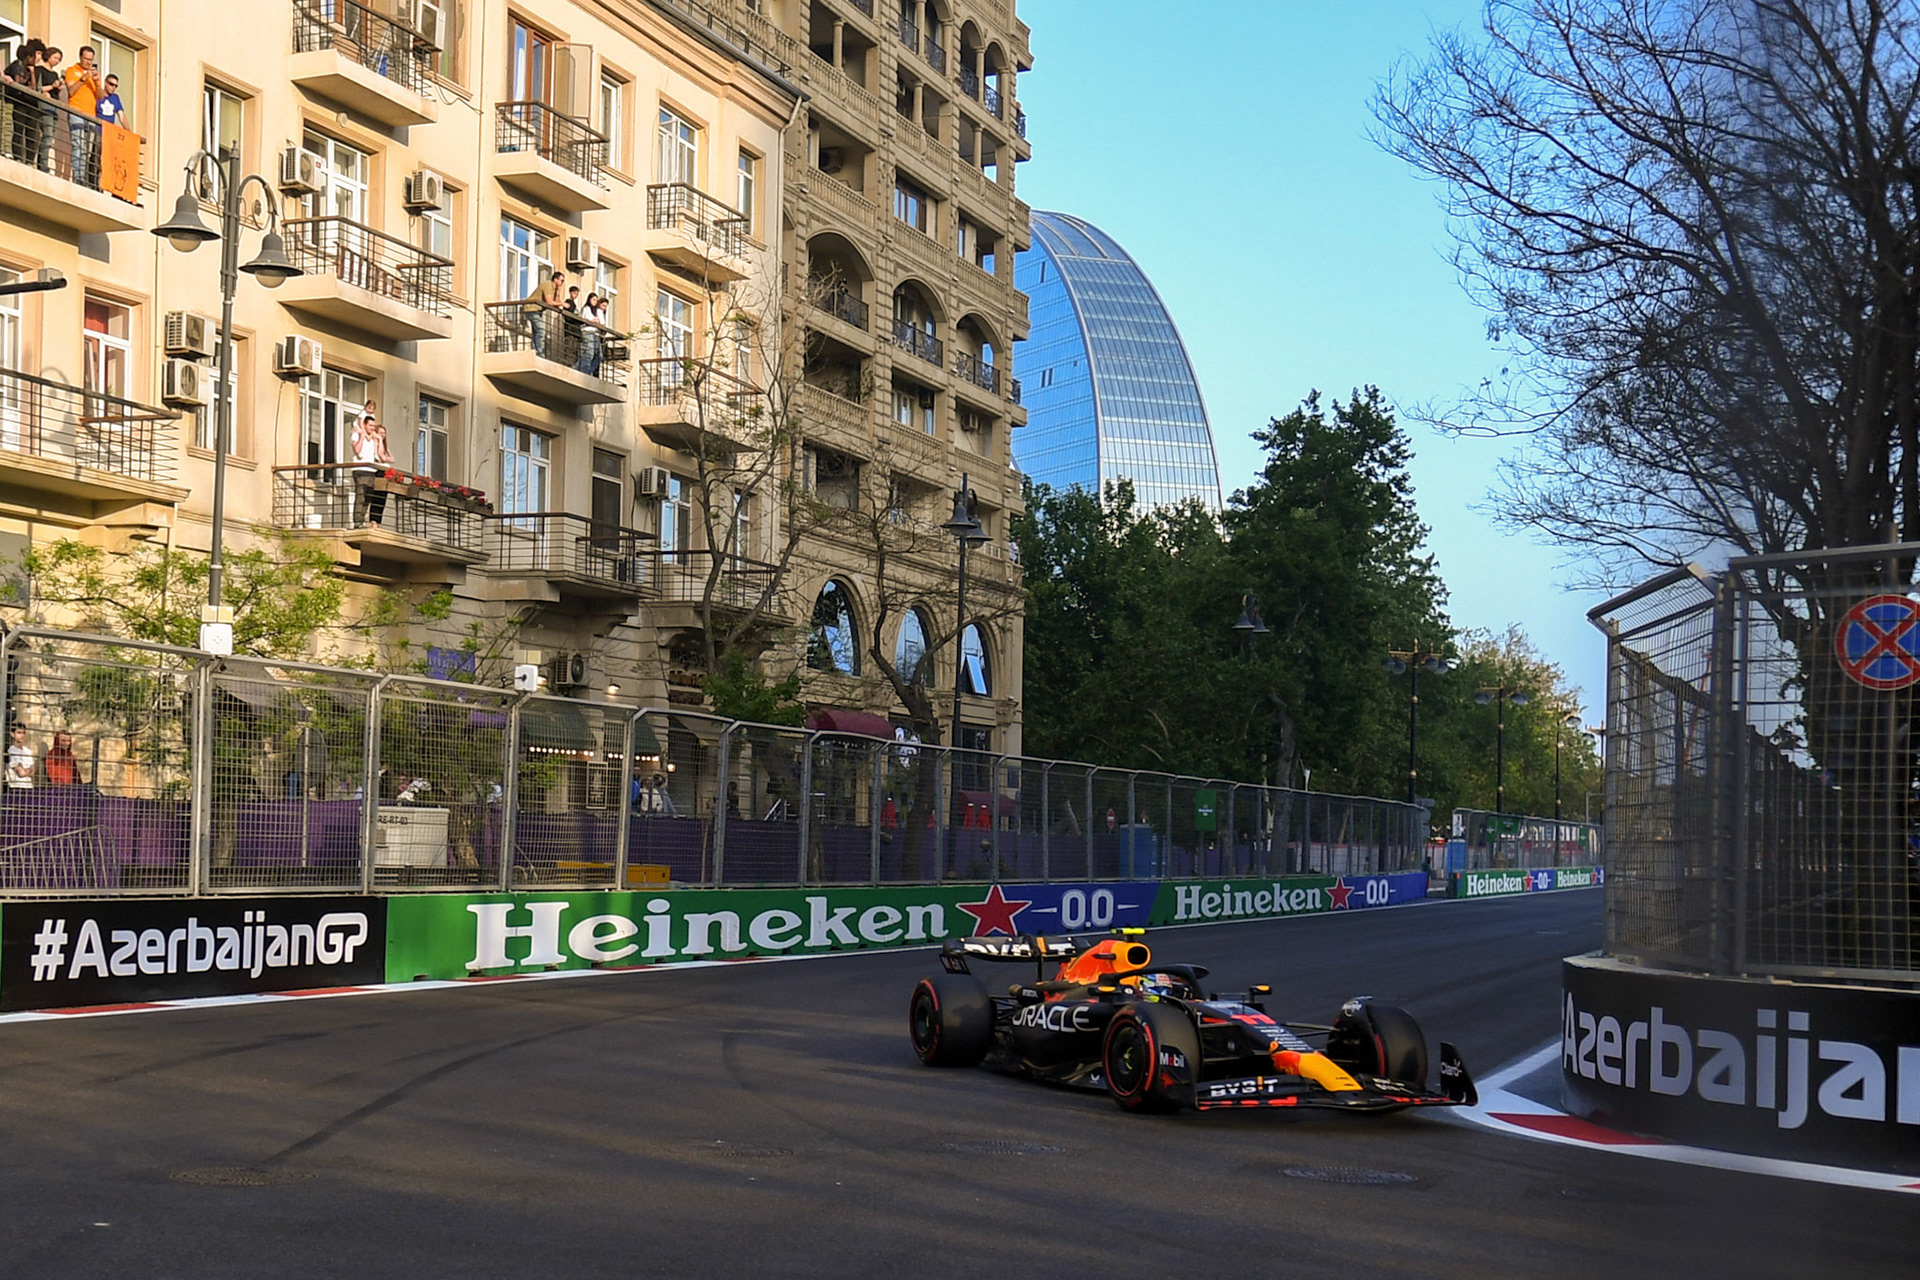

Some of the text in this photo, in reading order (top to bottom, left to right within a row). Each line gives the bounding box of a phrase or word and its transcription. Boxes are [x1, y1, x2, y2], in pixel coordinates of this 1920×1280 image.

[1174, 879, 1389, 920] Heineken 0.0
[1466, 873, 1523, 896] Heineken
[1557, 870, 1591, 888] Heineken
[30, 910, 369, 982] #AzerbaijanGP
[465, 888, 1114, 970] Heineken 0.0
[1160, 1052, 1185, 1068] Mobil
[1561, 990, 1920, 1129] Azerbaija
